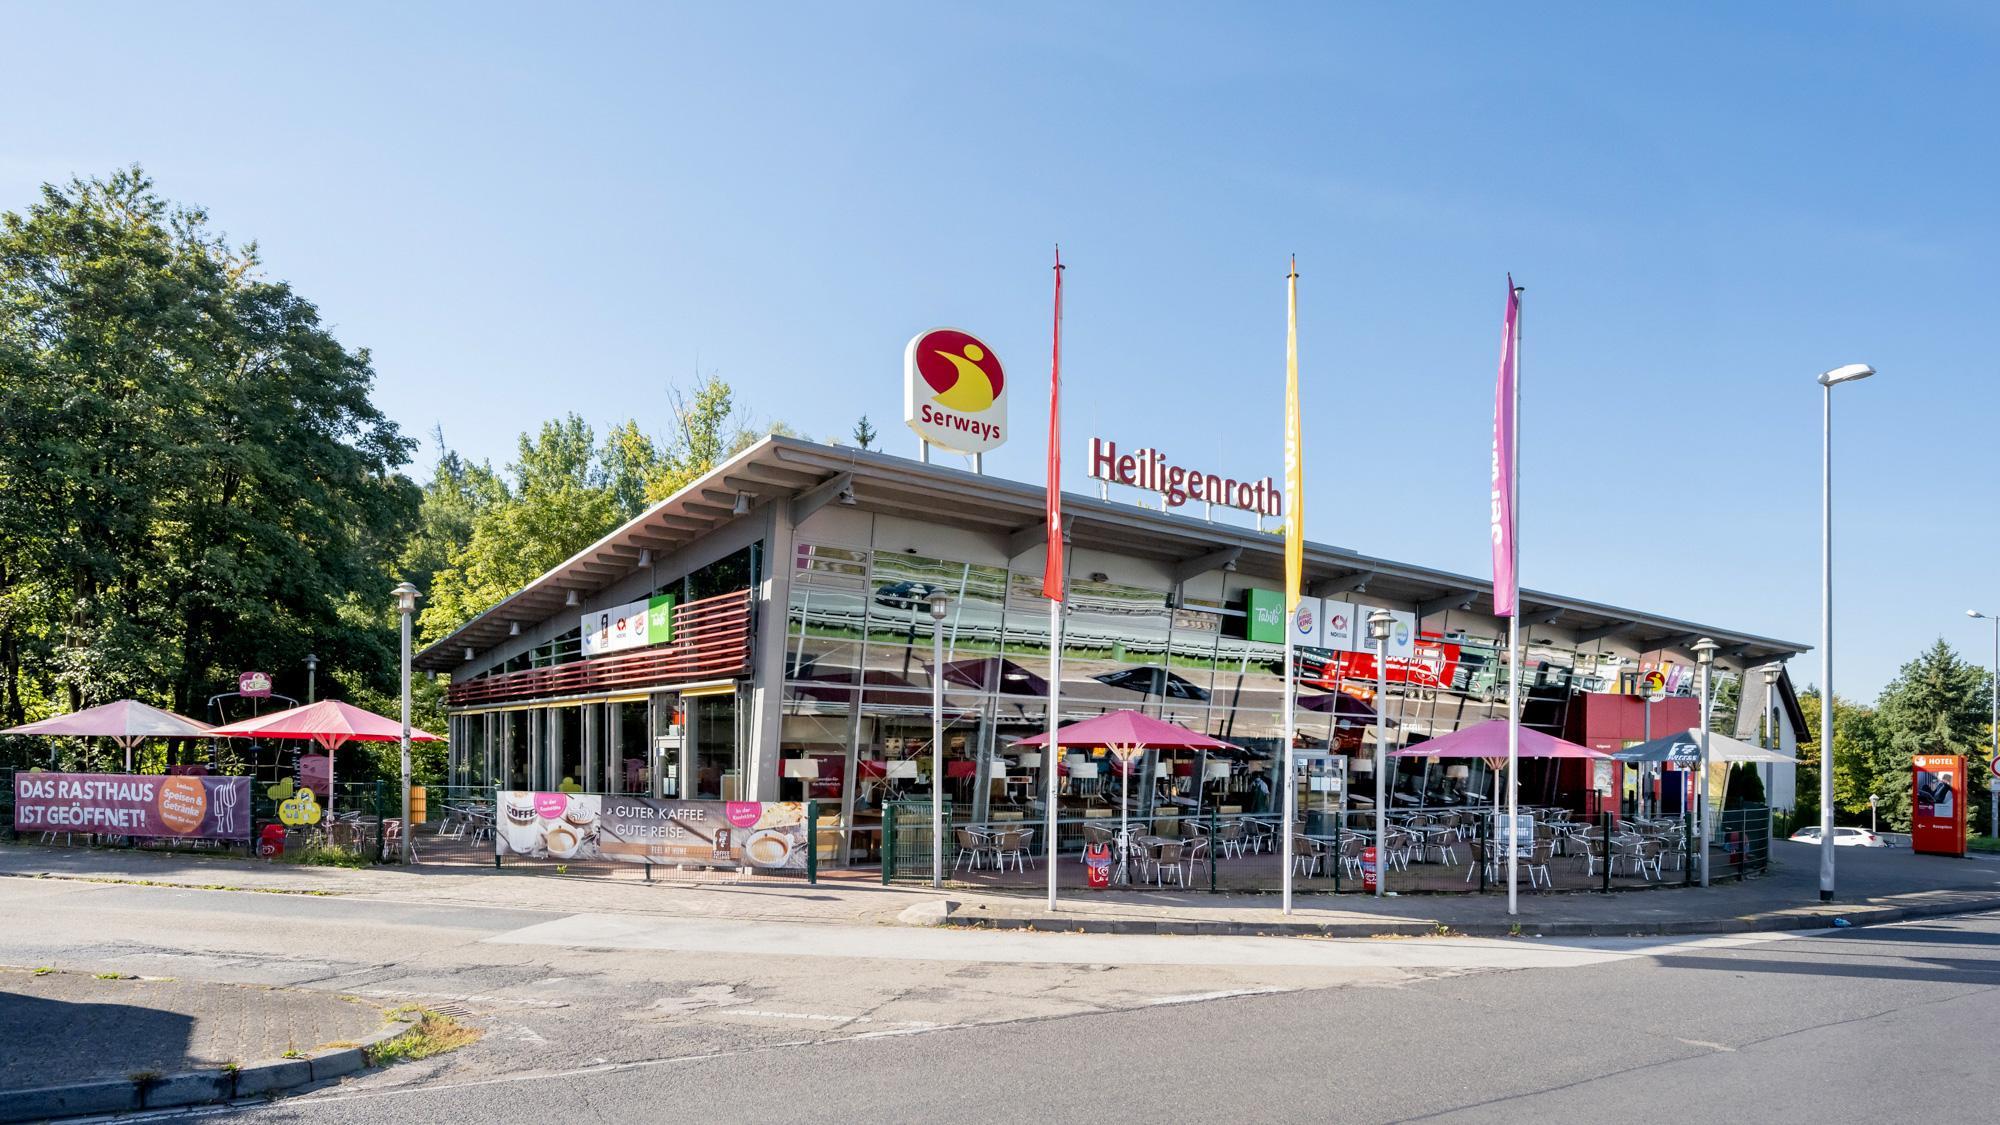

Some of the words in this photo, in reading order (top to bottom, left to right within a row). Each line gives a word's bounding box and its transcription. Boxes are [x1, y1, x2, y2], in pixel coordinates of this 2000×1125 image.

[921, 404, 1000, 441] Serways
[1089, 437, 1282, 516] Heiligenroth
[20, 780, 55, 799] DAS
[58, 780, 154, 801] RASTHAUS
[163, 788, 195, 805] Speisen
[196, 795, 203, 806] &
[20, 805, 45, 824] IST
[47, 801, 146, 828] GEÖFFNET!
[163, 800, 200, 817] Getränke
[616, 806, 654, 819] GUTER
[658, 808, 708, 821] KAFFEE.
[615, 824, 647, 837] GUTE
